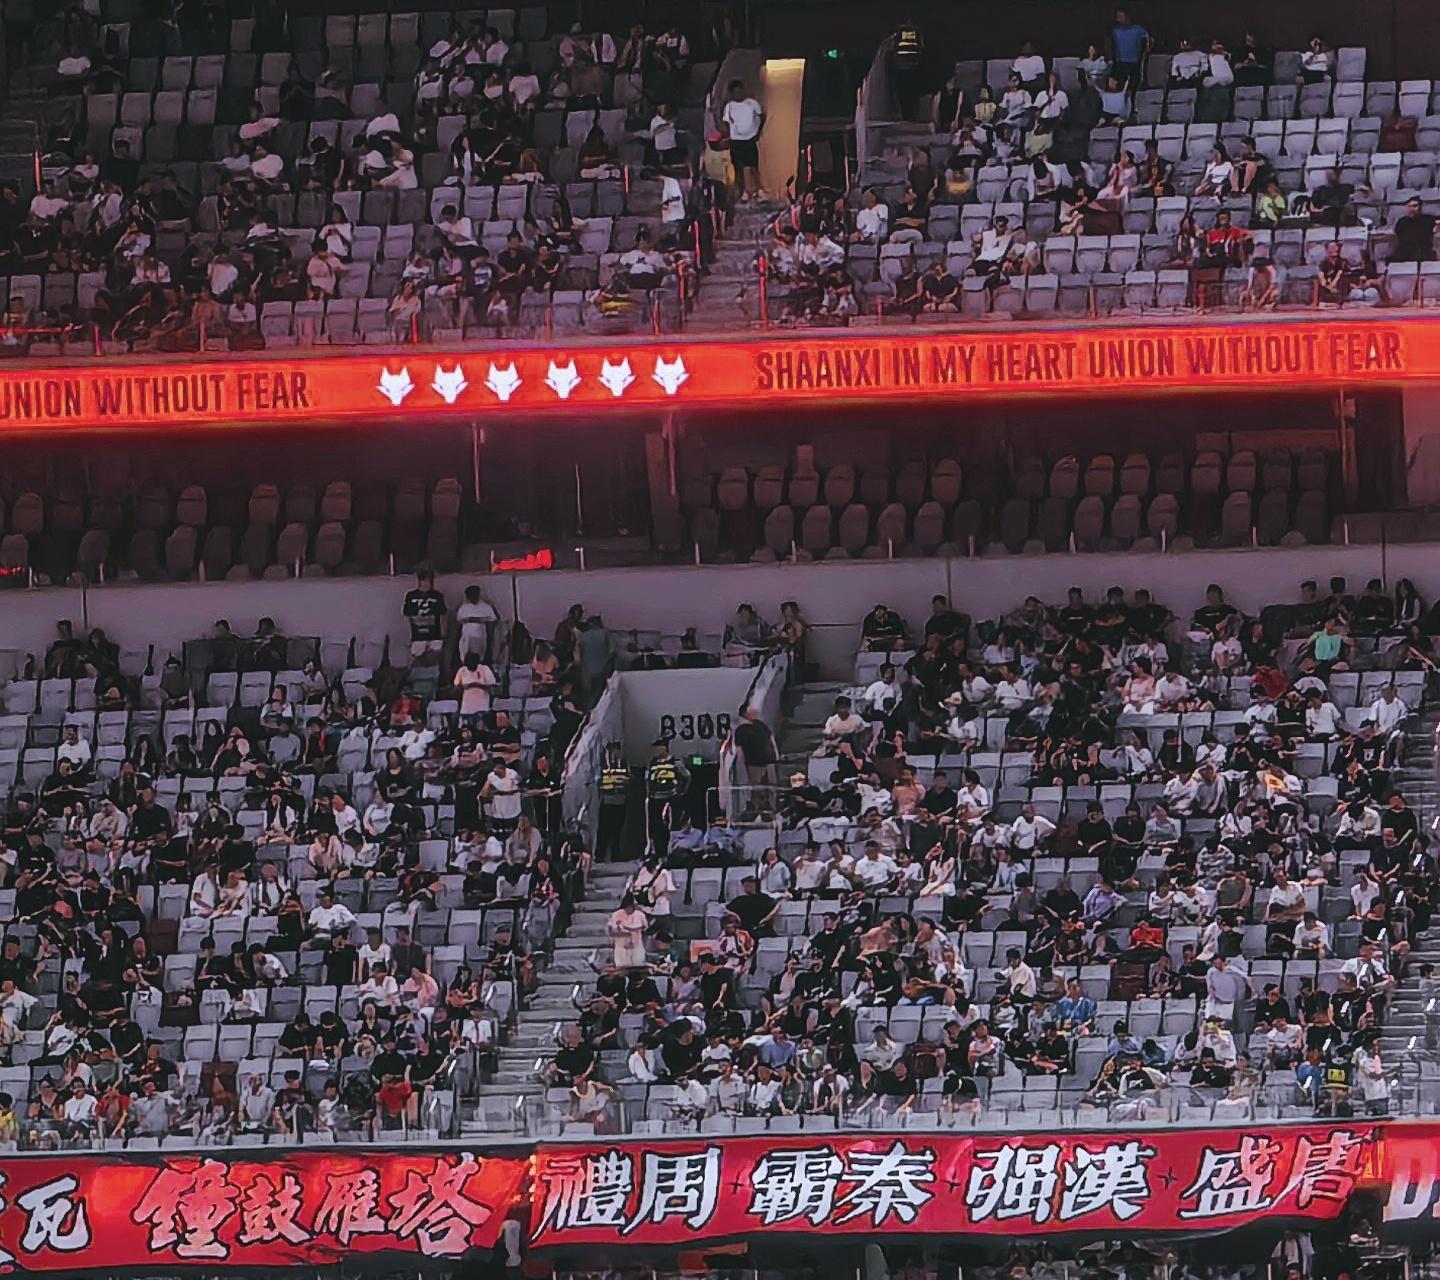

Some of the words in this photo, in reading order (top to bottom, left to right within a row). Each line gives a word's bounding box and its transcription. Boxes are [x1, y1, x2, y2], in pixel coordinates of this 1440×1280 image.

[756, 345, 883, 390] SHAANXI
[890, 344, 925, 386] IN
[931, 342, 980, 385] MY
[986, 340, 1077, 383] HEART
[1088, 336, 1180, 378] UNION
[1186, 333, 1324, 376] WITHOUT
[1329, 330, 1402, 372] FEAR
[93, 371, 226, 417] WITHOUT
[236, 369, 311, 412] FEAR
